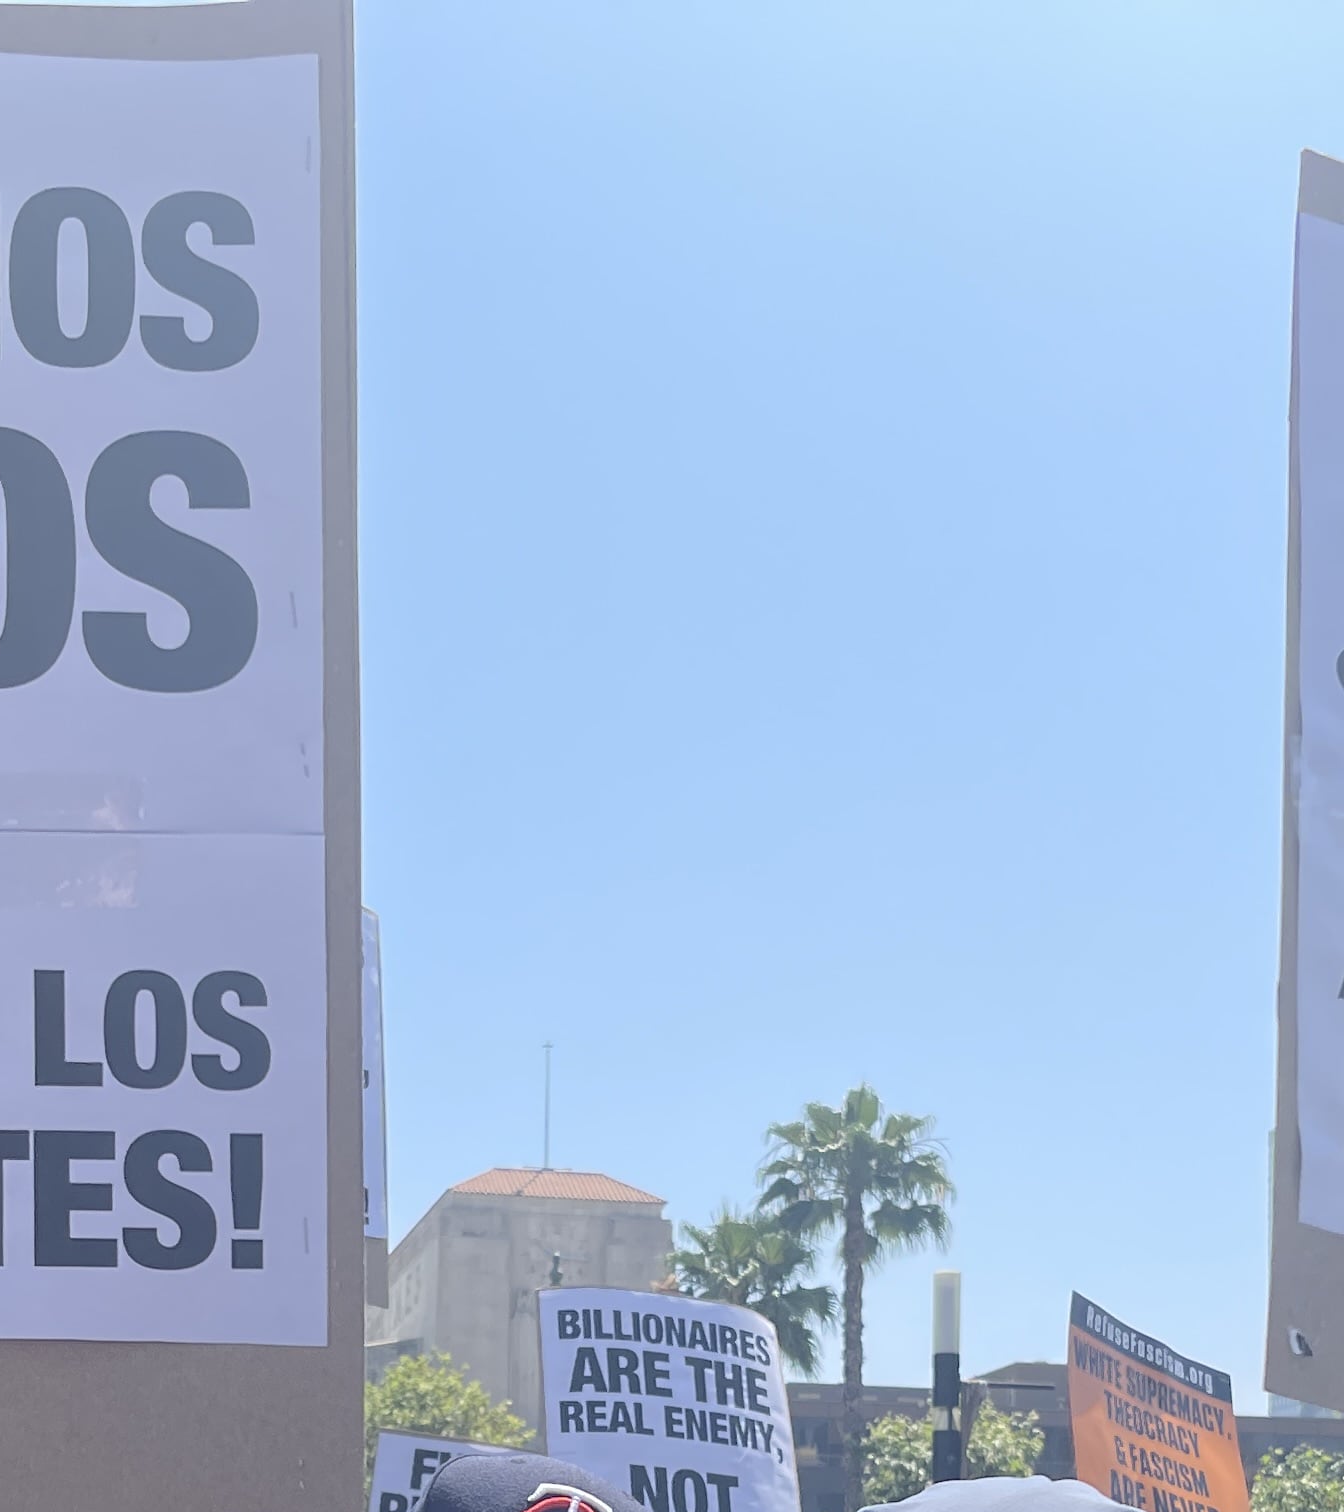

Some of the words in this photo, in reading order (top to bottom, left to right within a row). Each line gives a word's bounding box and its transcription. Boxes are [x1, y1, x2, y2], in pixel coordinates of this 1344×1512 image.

[33, 969, 271, 1089] LOS
[557, 1309, 771, 1366] BILLIONAIRES
[1073, 1335, 1121, 1390] WHITE
[570, 1347, 673, 1398] ARE
[684, 1356, 772, 1416] THE
[559, 1400, 654, 1436] REAL
[664, 1405, 784, 1464] ENEMY,
[1104, 1389, 1200, 1458] THEOCRACY
[1110, 1469, 1146, 1509] ARE
[1129, 1443, 1210, 1498] FASCISM
